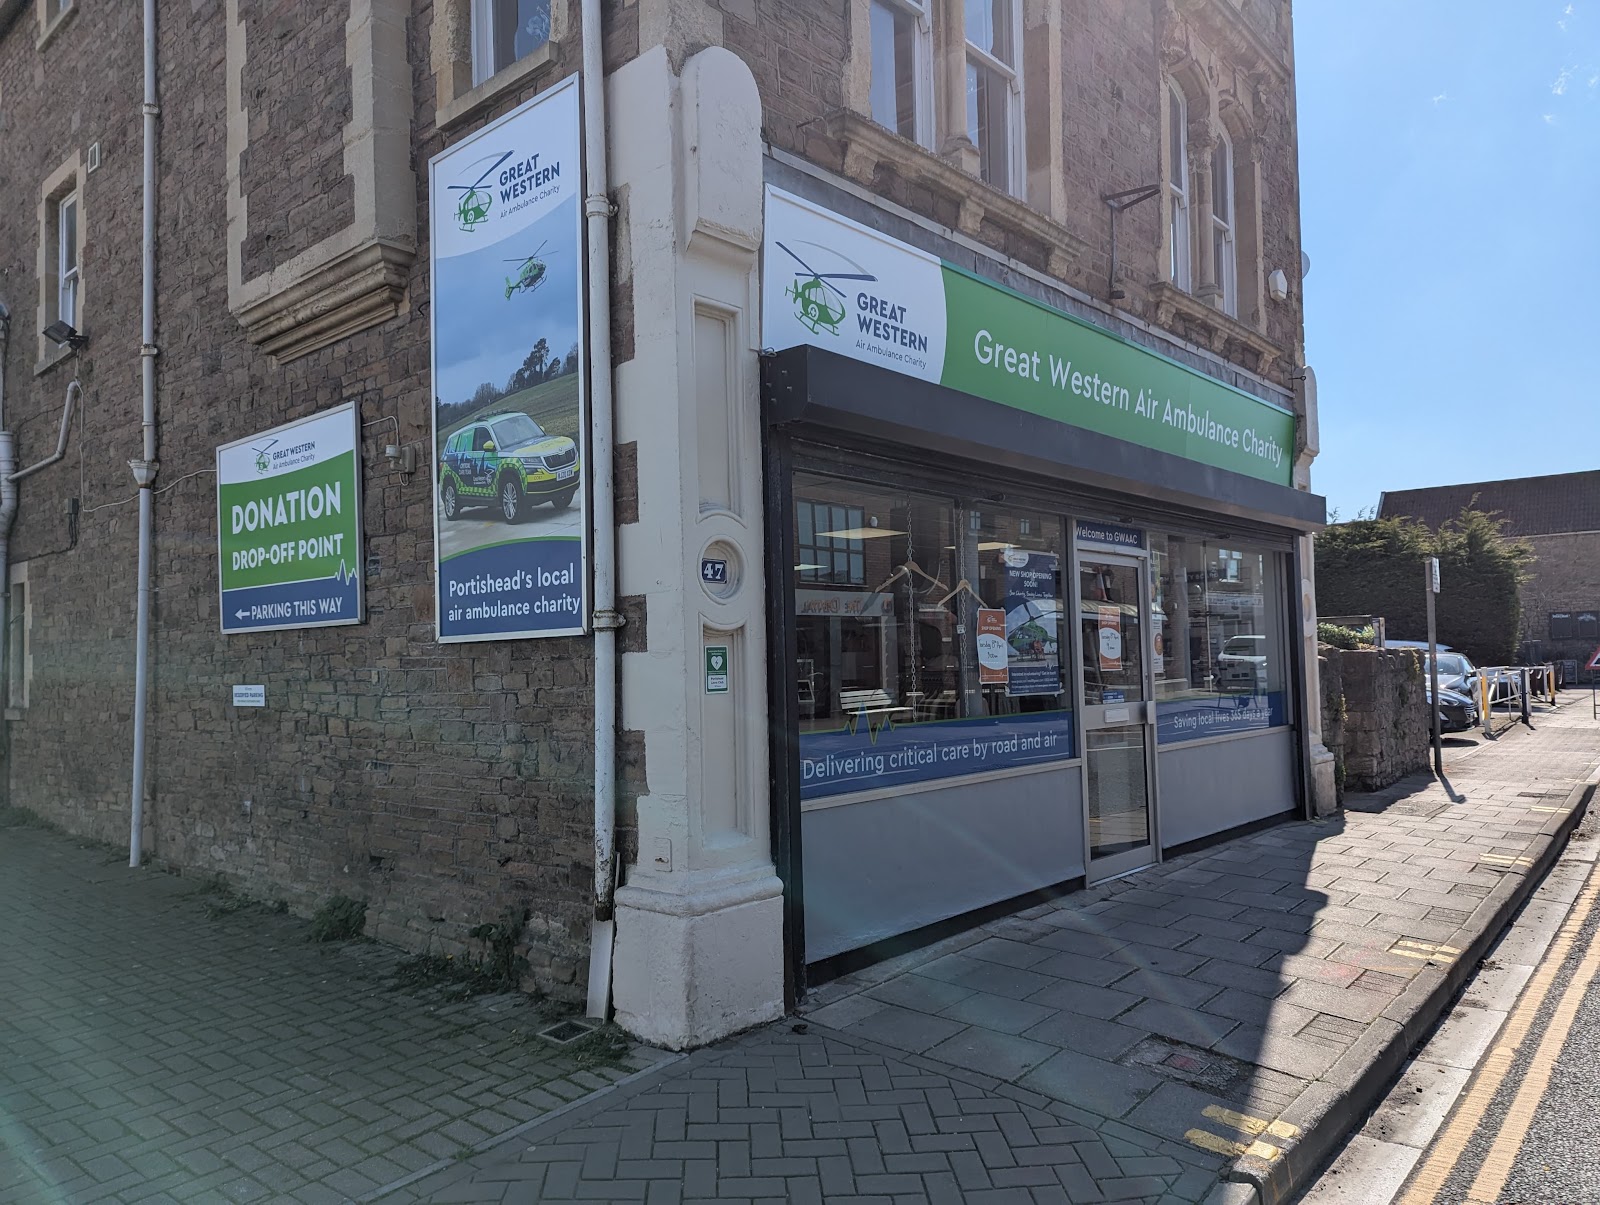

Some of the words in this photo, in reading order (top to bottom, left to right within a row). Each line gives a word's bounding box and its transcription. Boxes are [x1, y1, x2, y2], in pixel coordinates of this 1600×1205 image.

[500, 153, 539, 186] GREAT
[500, 161, 560, 204] WESTERN
[500, 209, 508, 219] Air
[509, 196, 538, 215] Ambulance
[540, 185, 560, 200] Charity
[857, 292, 907, 324] GREAT
[857, 313, 927, 354] WESTERN
[856, 339, 866, 349] Air
[867, 343, 903, 361] Ambulance
[904, 354, 927, 370] Charity
[974, 329, 1041, 382] Great
[1049, 354, 1129, 411] Western
[1134, 388, 1159, 420] Air
[1162, 398, 1239, 448] Ambulance
[1242, 428, 1283, 469] Charity
[273, 449, 290, 460] GREAT
[290, 441, 316, 456] WESTERN
[279, 457, 300, 468] Ambulance
[301, 453, 315, 463] Charity
[232, 481, 341, 535] DONATION
[1076, 526, 1105, 540] Welcome
[1106, 531, 1113, 541] to
[1114, 532, 1138, 545] GWAAC
[232, 541, 295, 571] DROP-OFF
[299, 533, 343, 561] POINT
[449, 569, 533, 597] Portishead's
[537, 562, 574, 588] local
[703, 563, 724, 580] 47
[1009, 570, 1020, 578] NEW
[1021, 570, 1032, 579] SHOP
[1033, 571, 1052, 580] OPENING
[251, 602, 292, 620] PARKING
[293, 600, 316, 616] THIS
[319, 597, 343, 614] WAY
[448, 604, 463, 621] air
[465, 600, 530, 620] ambulance
[534, 593, 581, 615] charity
[1174, 714, 1197, 728] Saving
[1198, 711, 1215, 725] local
[1215, 709, 1229, 723] lives
[1230, 709, 1242, 721] 365
[1242, 707, 1257, 721] days
[1261, 707, 1274, 719] year
[803, 751, 884, 779] Delivering
[889, 743, 937, 768] critical
[941, 745, 969, 761] care
[973, 739, 988, 760] by
[991, 733, 1018, 754] road
[1021, 731, 1041, 750] and
[1044, 730, 1057, 747] air
